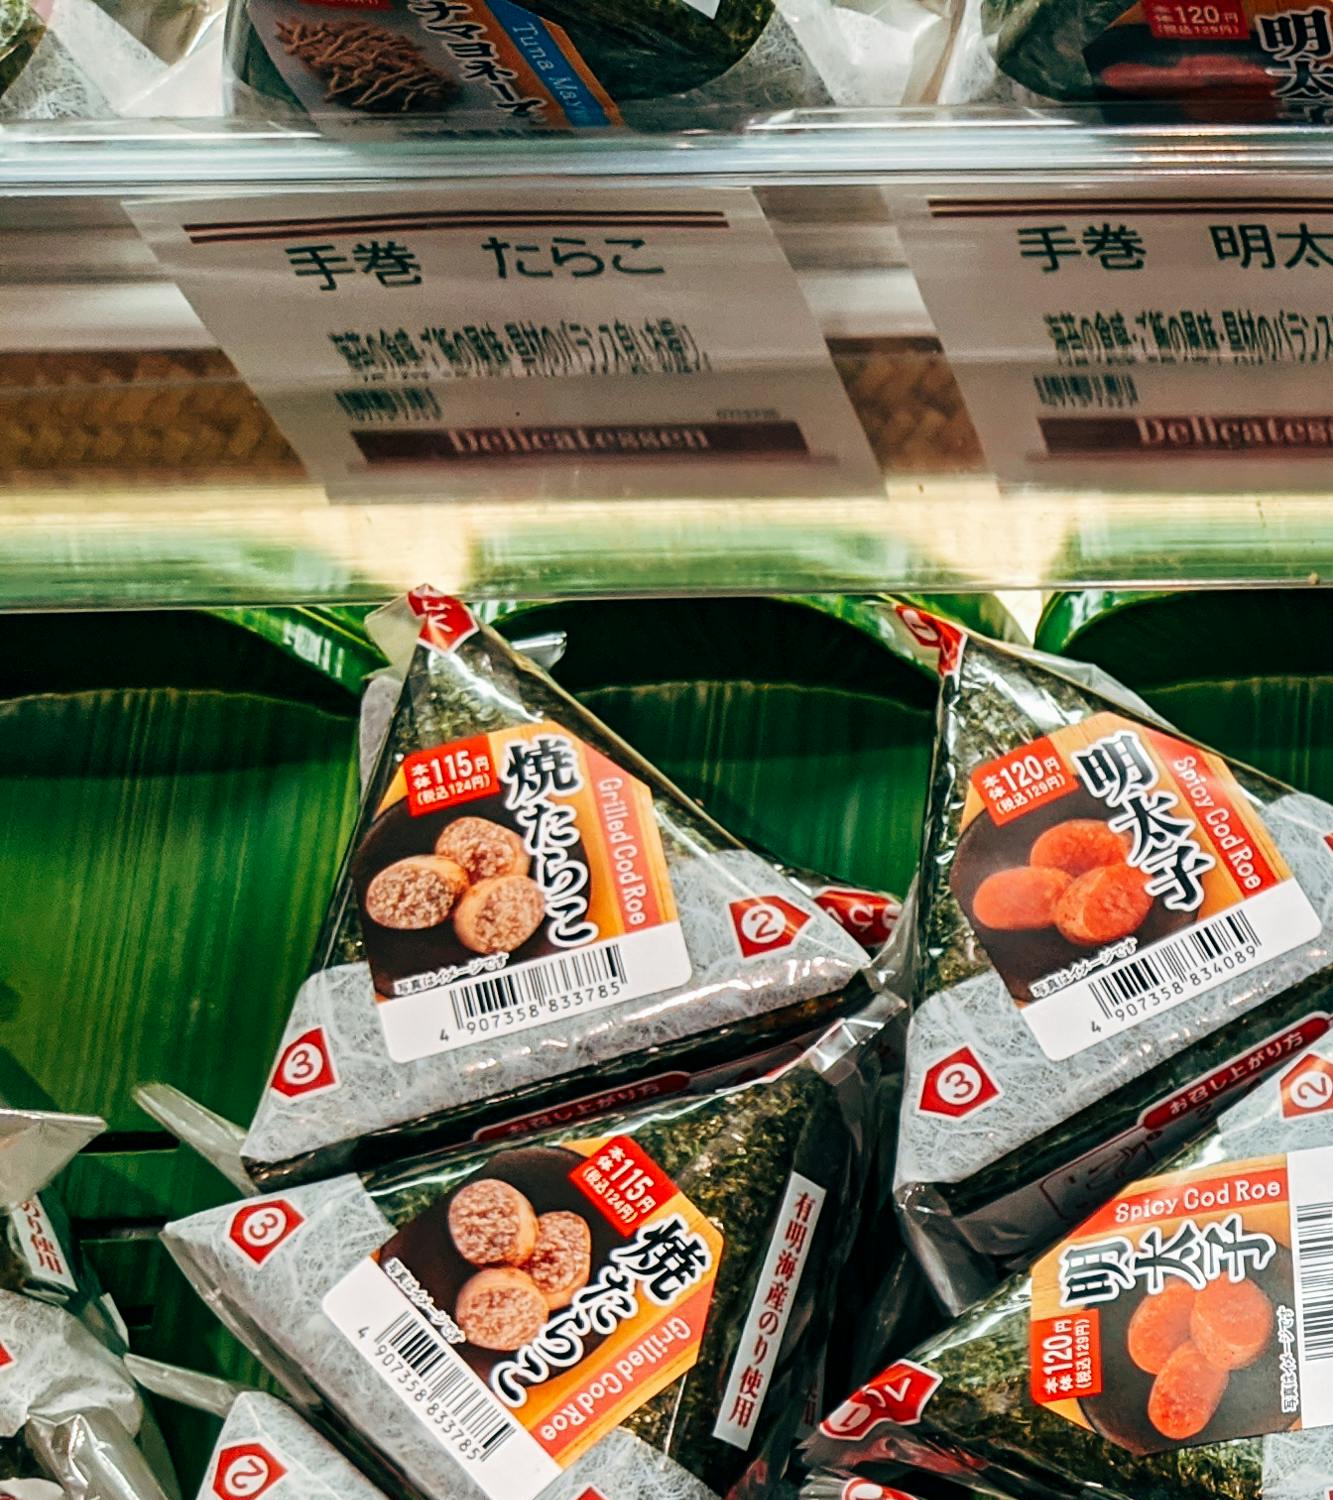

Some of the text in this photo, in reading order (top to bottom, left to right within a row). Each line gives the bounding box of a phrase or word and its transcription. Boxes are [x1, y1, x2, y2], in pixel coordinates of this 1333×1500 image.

[513, 21, 554, 72] Tuna
[285, 236, 665, 291] 手巻 たらこ
[1016, 222, 1147, 273] 手巻
[415, 772, 490, 806] (税込124円)
[992, 773, 1066, 816] (税込129円)
[1073, 734, 1212, 908] 明太子
[1169, 754, 1264, 891] Spicy Cod Roe
[506, 734, 593, 945] 焼たらこ
[593, 773, 654, 926] Grilled Cod Roe
[436, 980, 619, 1042] 4 907358 833785
[1168, 1031, 1304, 1115] お召し上がり方
[579, 1164, 640, 1225] (税込124円)
[1115, 1179, 1281, 1223] Spicy Cod Roe
[1064, 1216, 1272, 1304] 明太子
[494, 1215, 709, 1403] 焼たらこ
[728, 1191, 816, 1429] 有明海産のり使用
[538, 1312, 689, 1449] Grilled Cod Roe
[1074, 1318, 1091, 1390] (税込129円)
